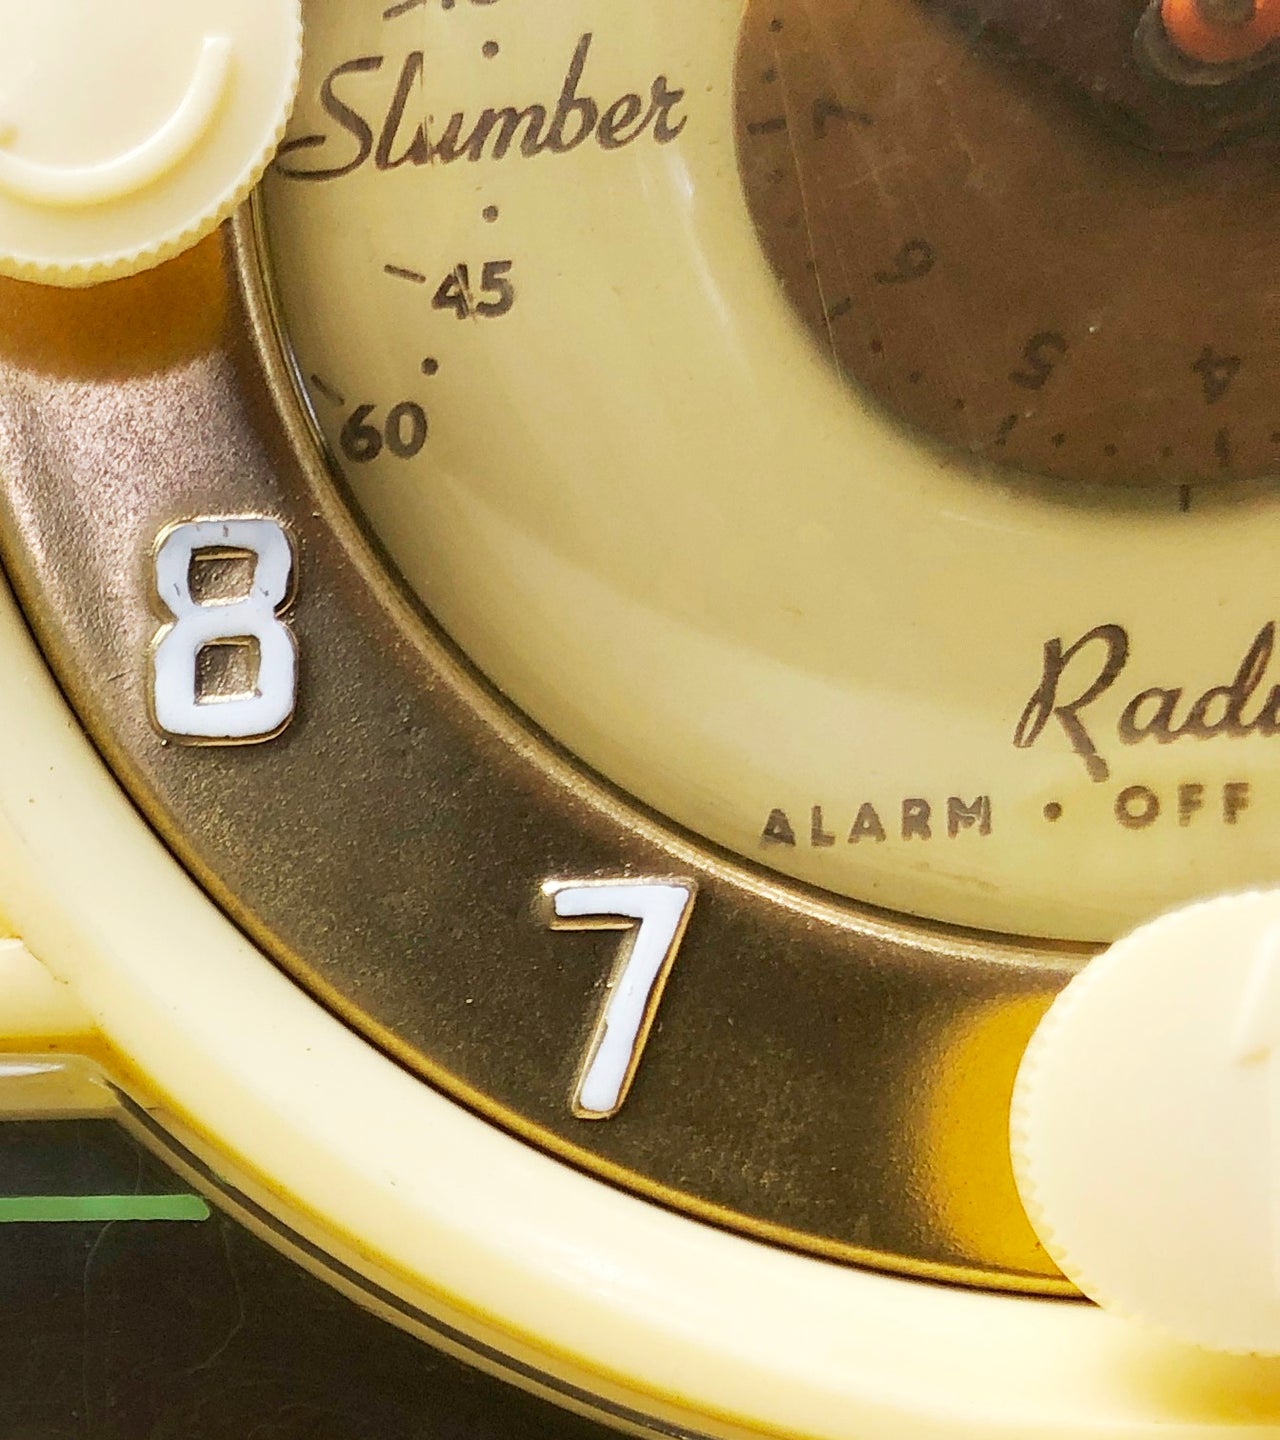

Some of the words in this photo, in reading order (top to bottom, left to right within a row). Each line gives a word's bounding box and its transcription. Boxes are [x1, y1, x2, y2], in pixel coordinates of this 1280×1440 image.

[276, 32, 688, 182] Slumber
[431, 261, 513, 319] 45
[338, 402, 429, 463] 60
[149, 514, 299, 745] 8
[758, 795, 993, 848] ALARM
[1114, 782, 1251, 829] OFF
[543, 874, 698, 1120] 7
